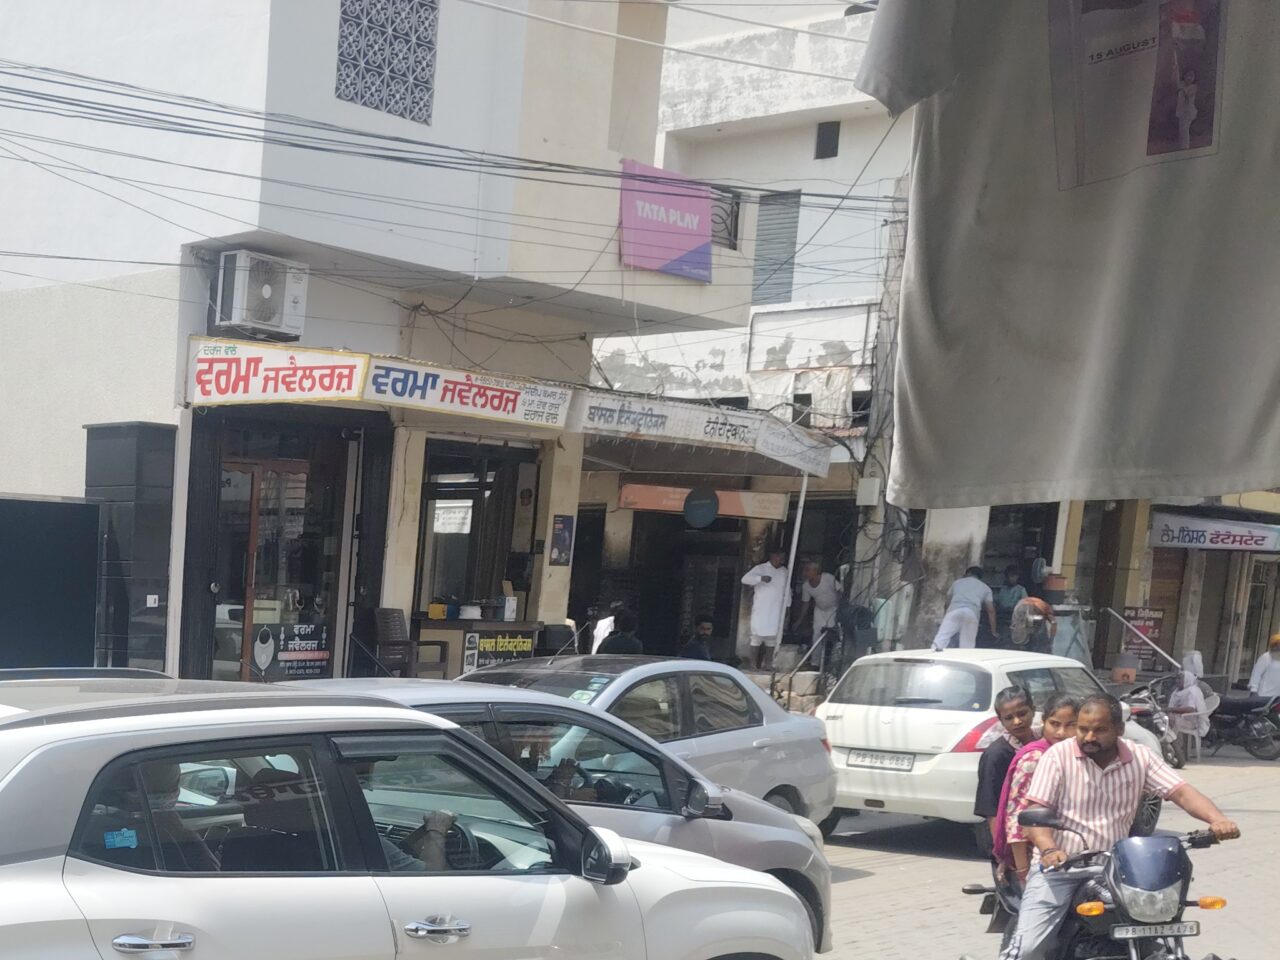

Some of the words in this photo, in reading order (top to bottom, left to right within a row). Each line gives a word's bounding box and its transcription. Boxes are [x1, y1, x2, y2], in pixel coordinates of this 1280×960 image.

[1106, 37, 1157, 57] AUGUST
[635, 200, 667, 224] TATA
[669, 208, 699, 230] PLAY
[196, 356, 263, 397] ਵਰਮਾ
[372, 365, 440, 400] ਵਰਮਾ
